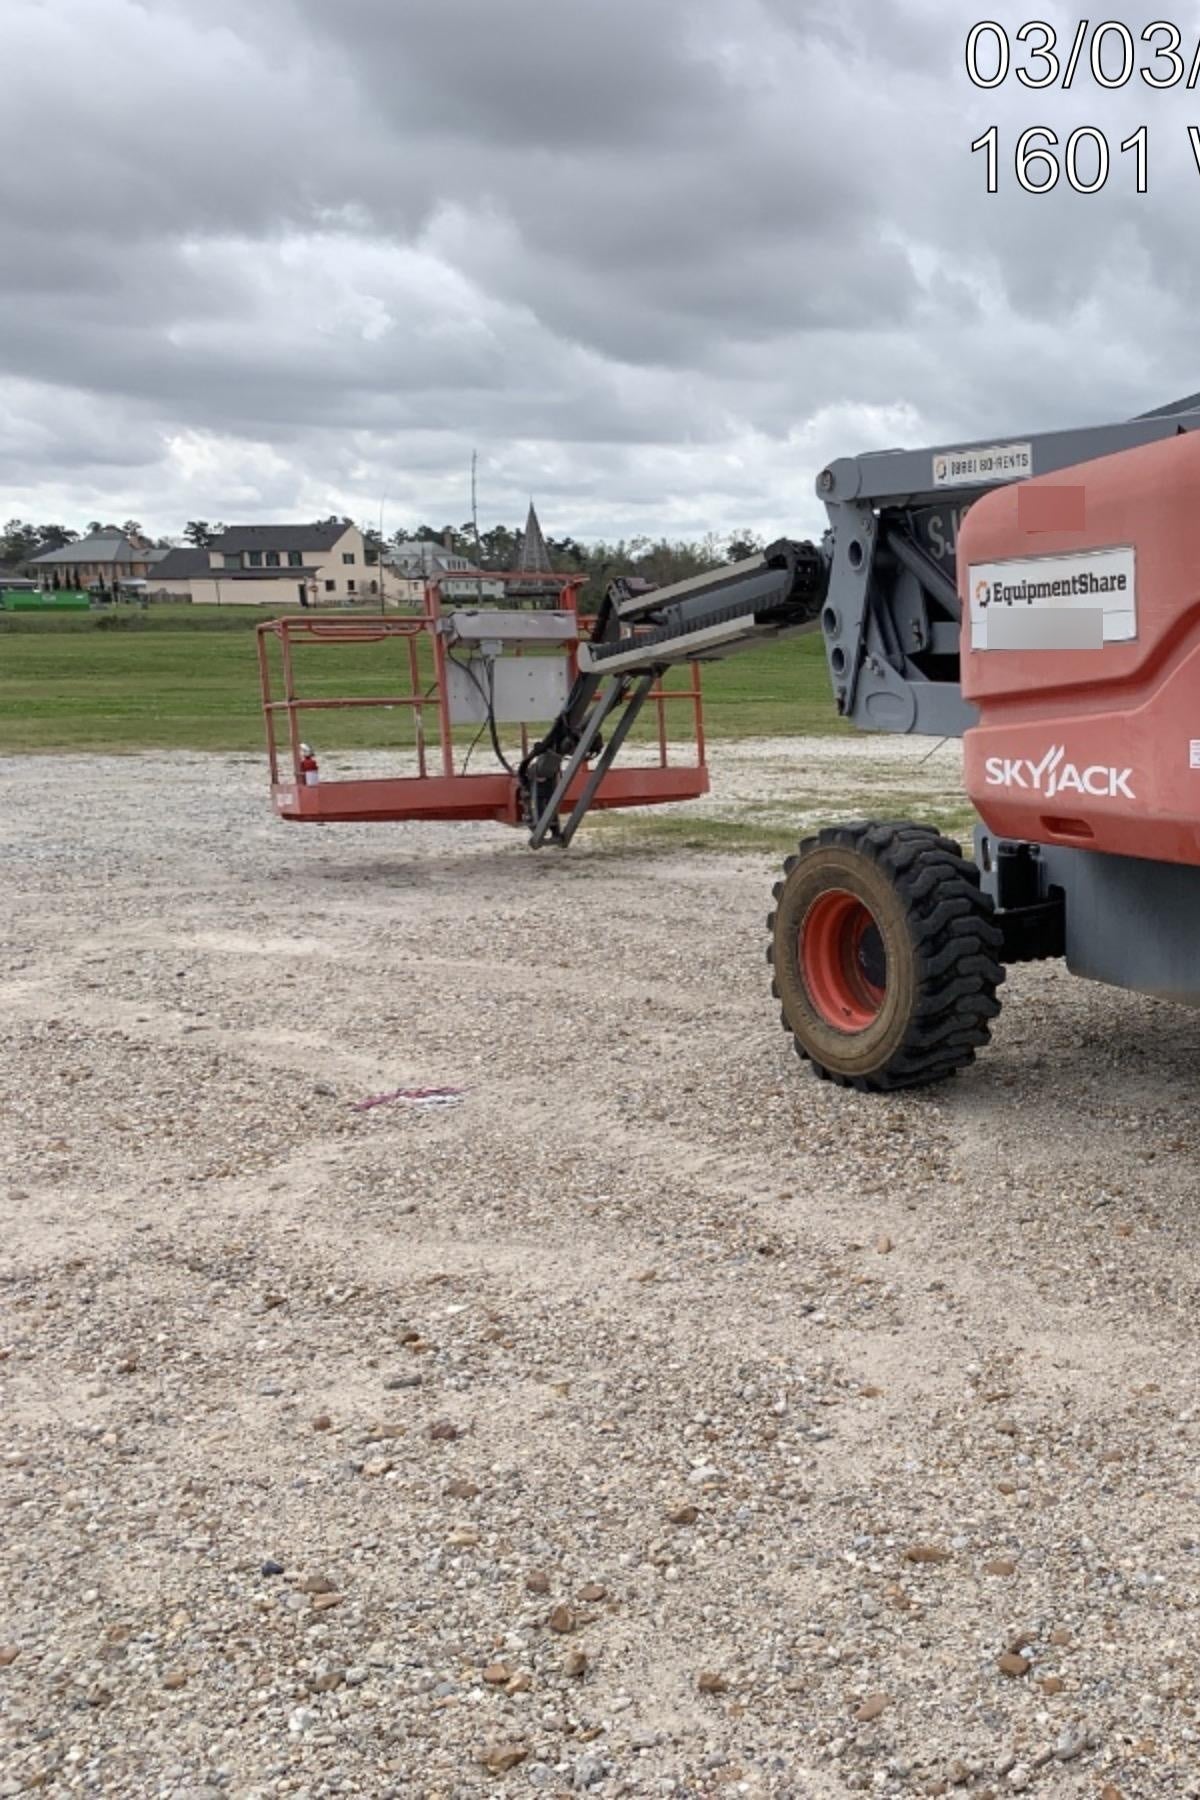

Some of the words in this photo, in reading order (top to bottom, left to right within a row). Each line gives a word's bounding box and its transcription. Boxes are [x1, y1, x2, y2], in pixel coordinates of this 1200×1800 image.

[928, 505, 970, 560] SJ
[992, 572, 1127, 606] EquipmentShare
[985, 744, 1137, 799] SKYJACK
